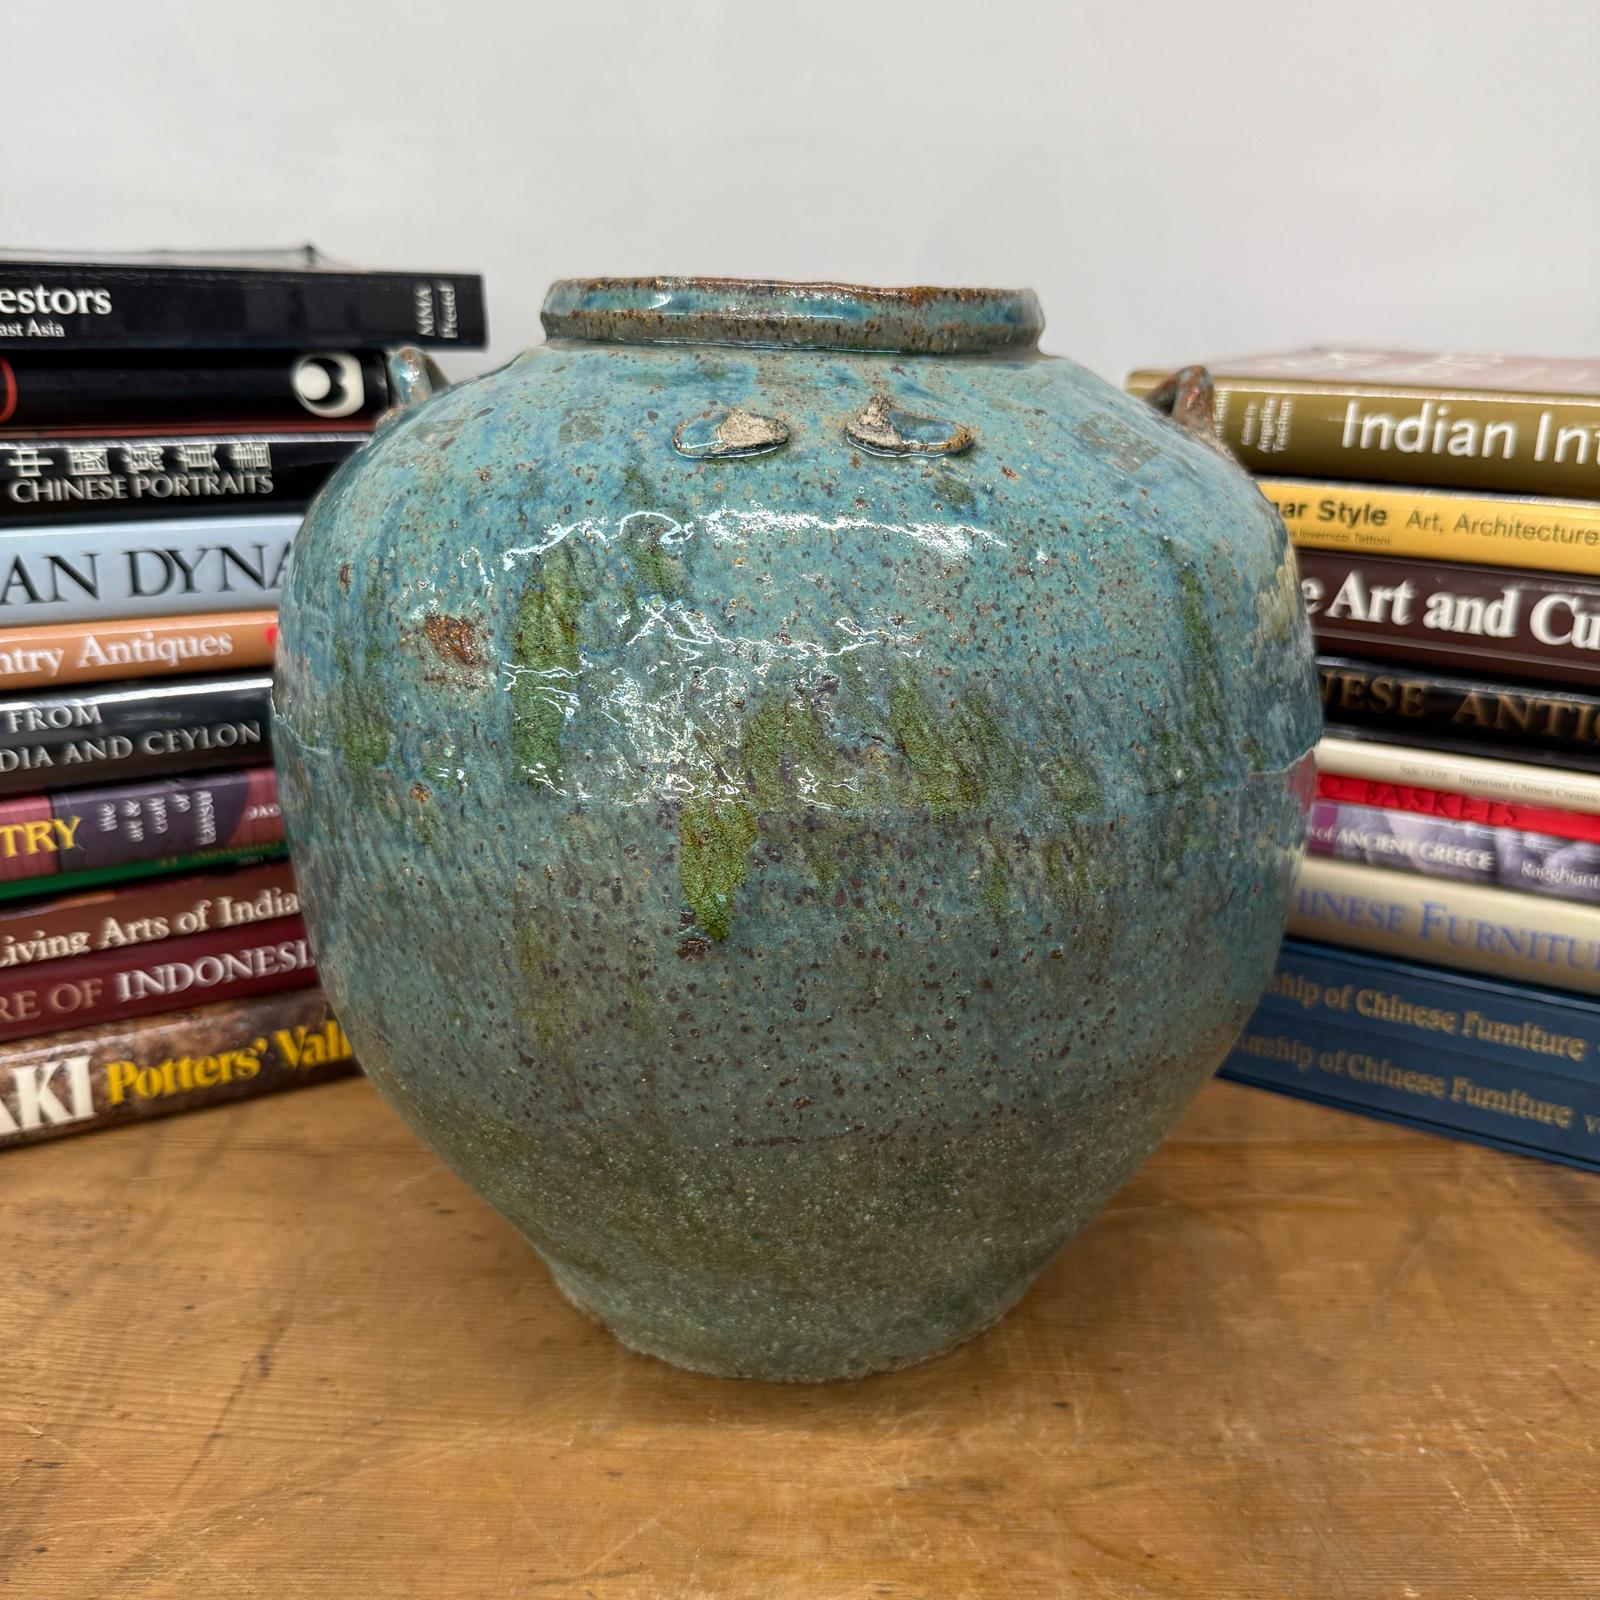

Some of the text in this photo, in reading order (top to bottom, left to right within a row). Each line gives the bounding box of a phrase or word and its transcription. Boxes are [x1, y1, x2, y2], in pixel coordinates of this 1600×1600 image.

[0, 283, 112, 315] estors
[27, 318, 65, 338] Asia
[1341, 400, 1516, 460] Indian
[9, 471, 274, 503] CHINESE PORTRAITS
[1318, 500, 1388, 529] Style
[1453, 512, 1600, 546] Architecture
[1, 553, 102, 606] AN
[1324, 569, 1416, 626] Art
[1422, 586, 1522, 638] and
[76, 630, 235, 668] Antiques
[8, 704, 103, 734] FROM
[62, 735, 133, 763] AND
[142, 720, 262, 756] CEYLON
[0, 816, 81, 857] TRY
[101, 916, 170, 949] Arts
[179, 900, 212, 932] of
[216, 886, 300, 927] India
[50, 978, 103, 1012] OF
[115, 939, 316, 1001] INDONESI
[1324, 984, 1355, 1011] of
[1356, 989, 1458, 1034] Chinese
[1462, 1011, 1586, 1061] Furniture
[1319, 1050, 1347, 1073] of
[1347, 1053, 1447, 1098] Chinese
[1450, 1077, 1576, 1129] Furniture
